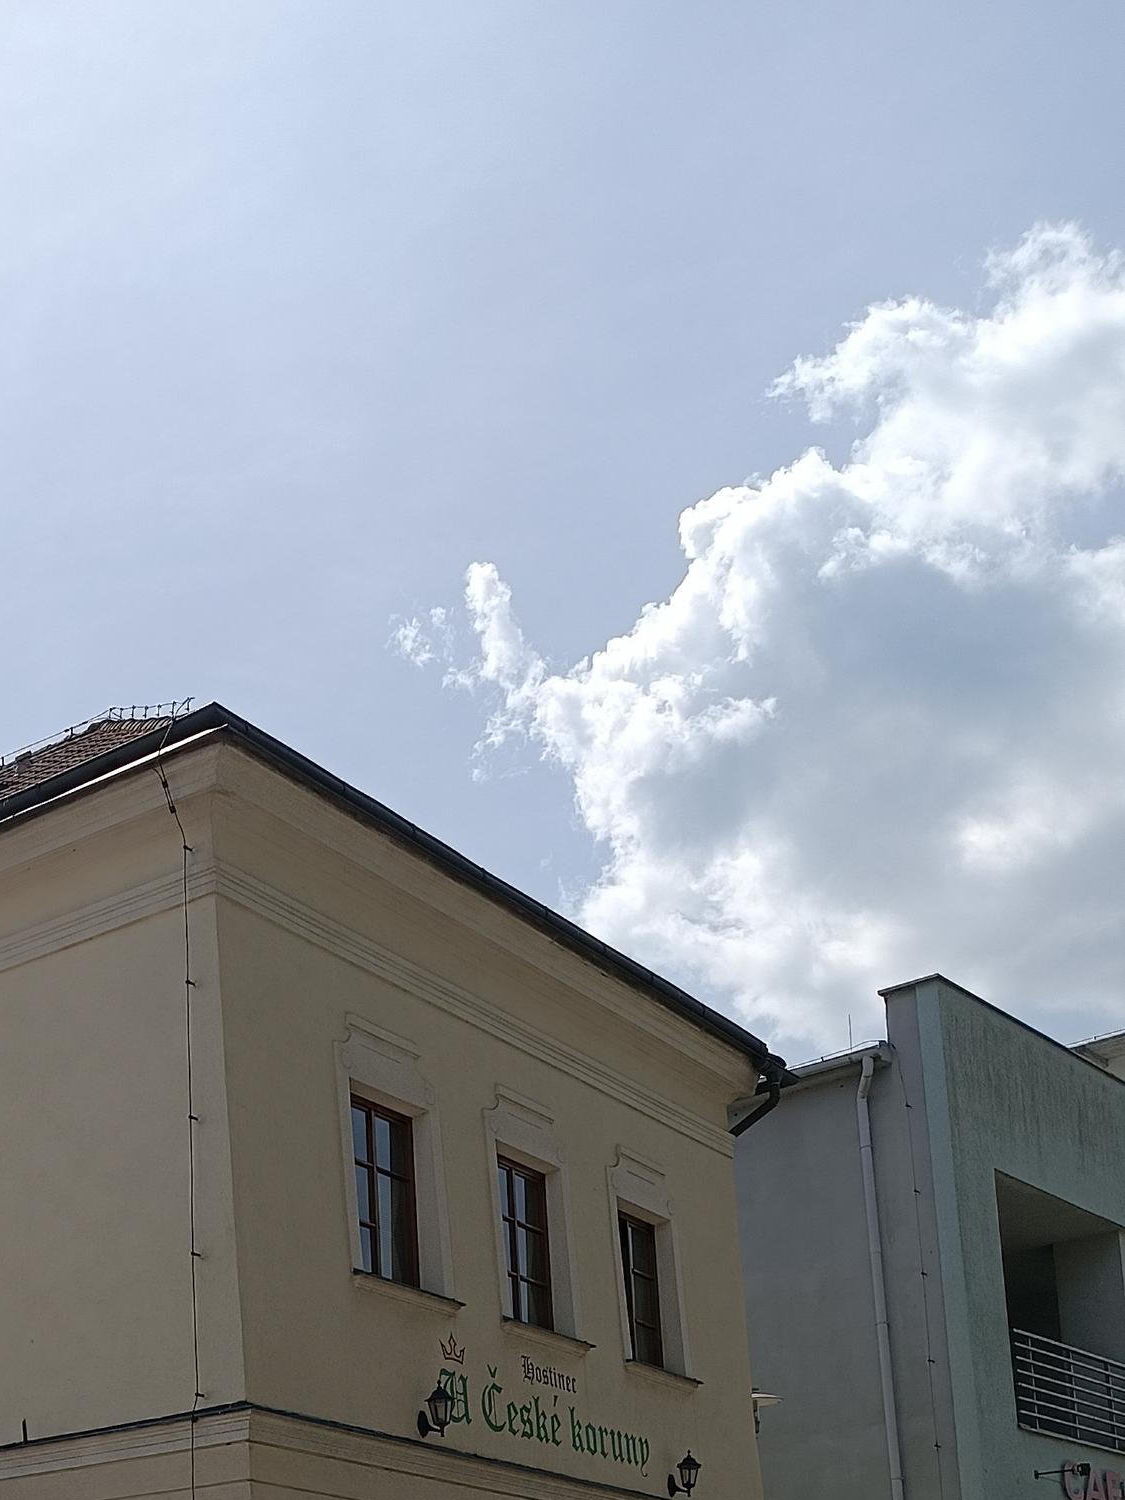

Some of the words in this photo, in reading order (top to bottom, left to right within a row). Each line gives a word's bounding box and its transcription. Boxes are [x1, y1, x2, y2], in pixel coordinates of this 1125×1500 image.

[521, 1355, 578, 1394] Hostinec
[482, 1364, 562, 1447] České
[568, 1406, 650, 1477] koruny
